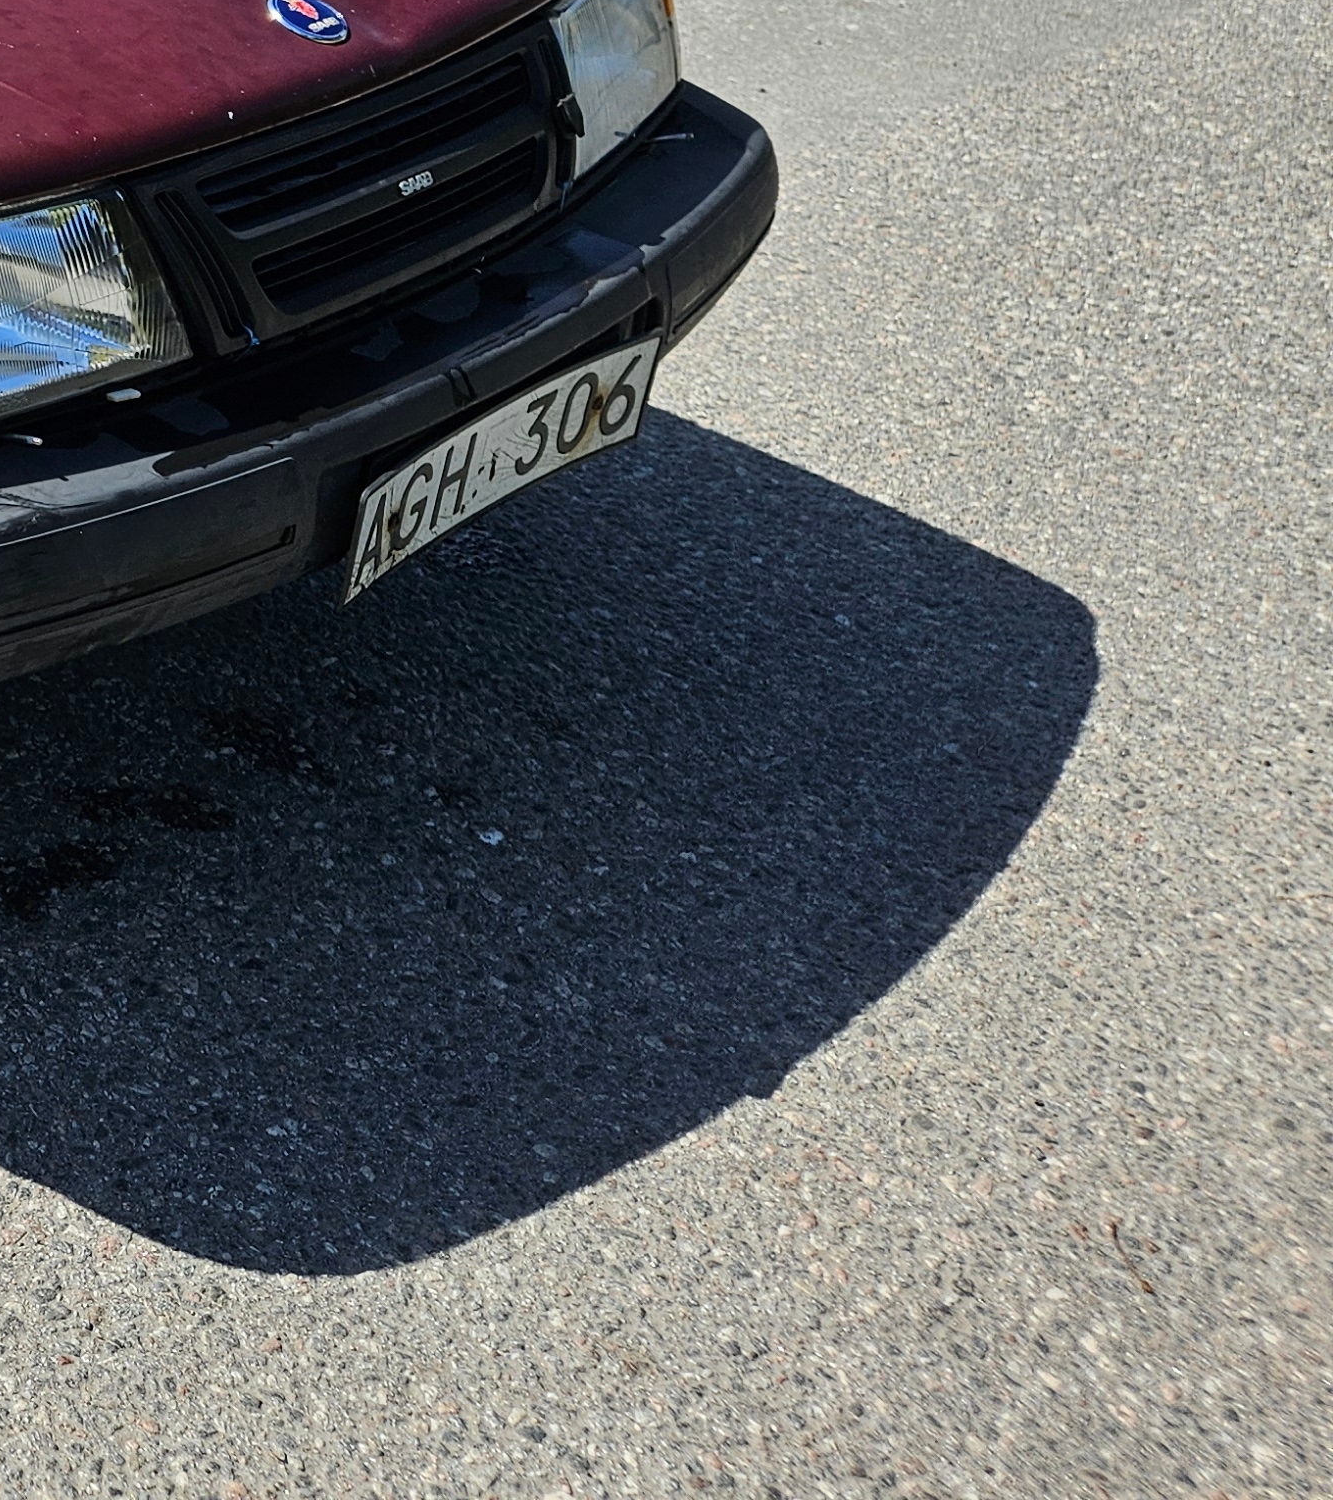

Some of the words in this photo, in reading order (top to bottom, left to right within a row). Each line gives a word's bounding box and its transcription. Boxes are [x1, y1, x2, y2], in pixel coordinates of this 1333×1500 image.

[308, 16, 340, 33] SAAB
[398, 170, 434, 197] SAAB
[352, 431, 478, 590] AGH
[514, 353, 643, 475] 306
